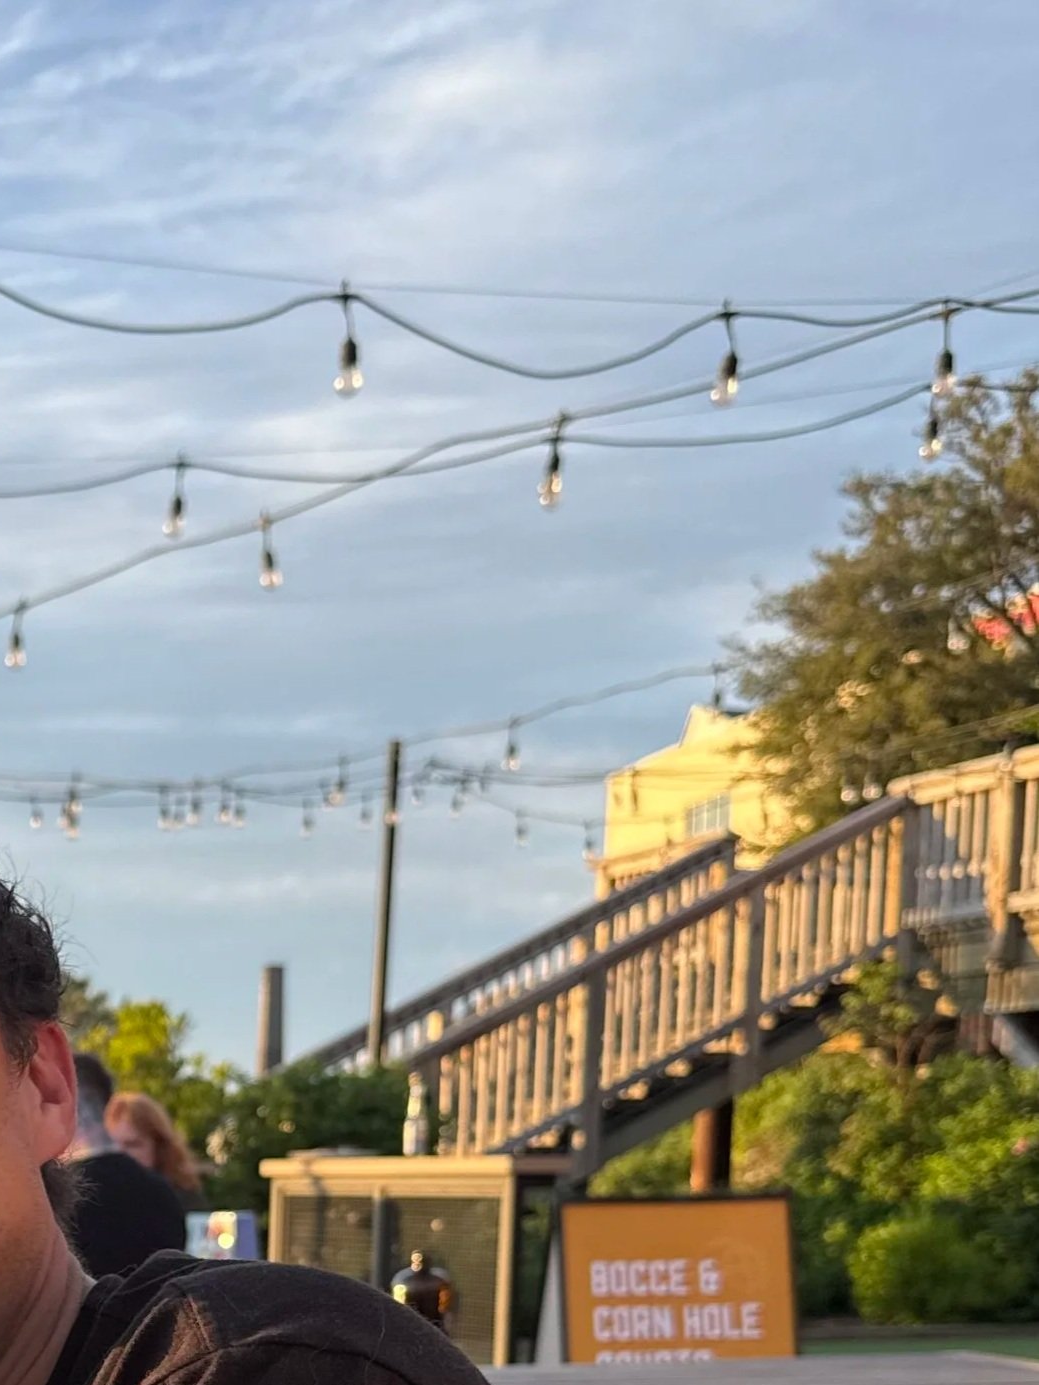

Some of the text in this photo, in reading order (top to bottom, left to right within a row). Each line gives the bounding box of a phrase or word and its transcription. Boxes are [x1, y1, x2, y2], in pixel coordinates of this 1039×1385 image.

[590, 1258, 720, 1297] BOCCE &
[593, 1302, 763, 1341] CORN HOLE
